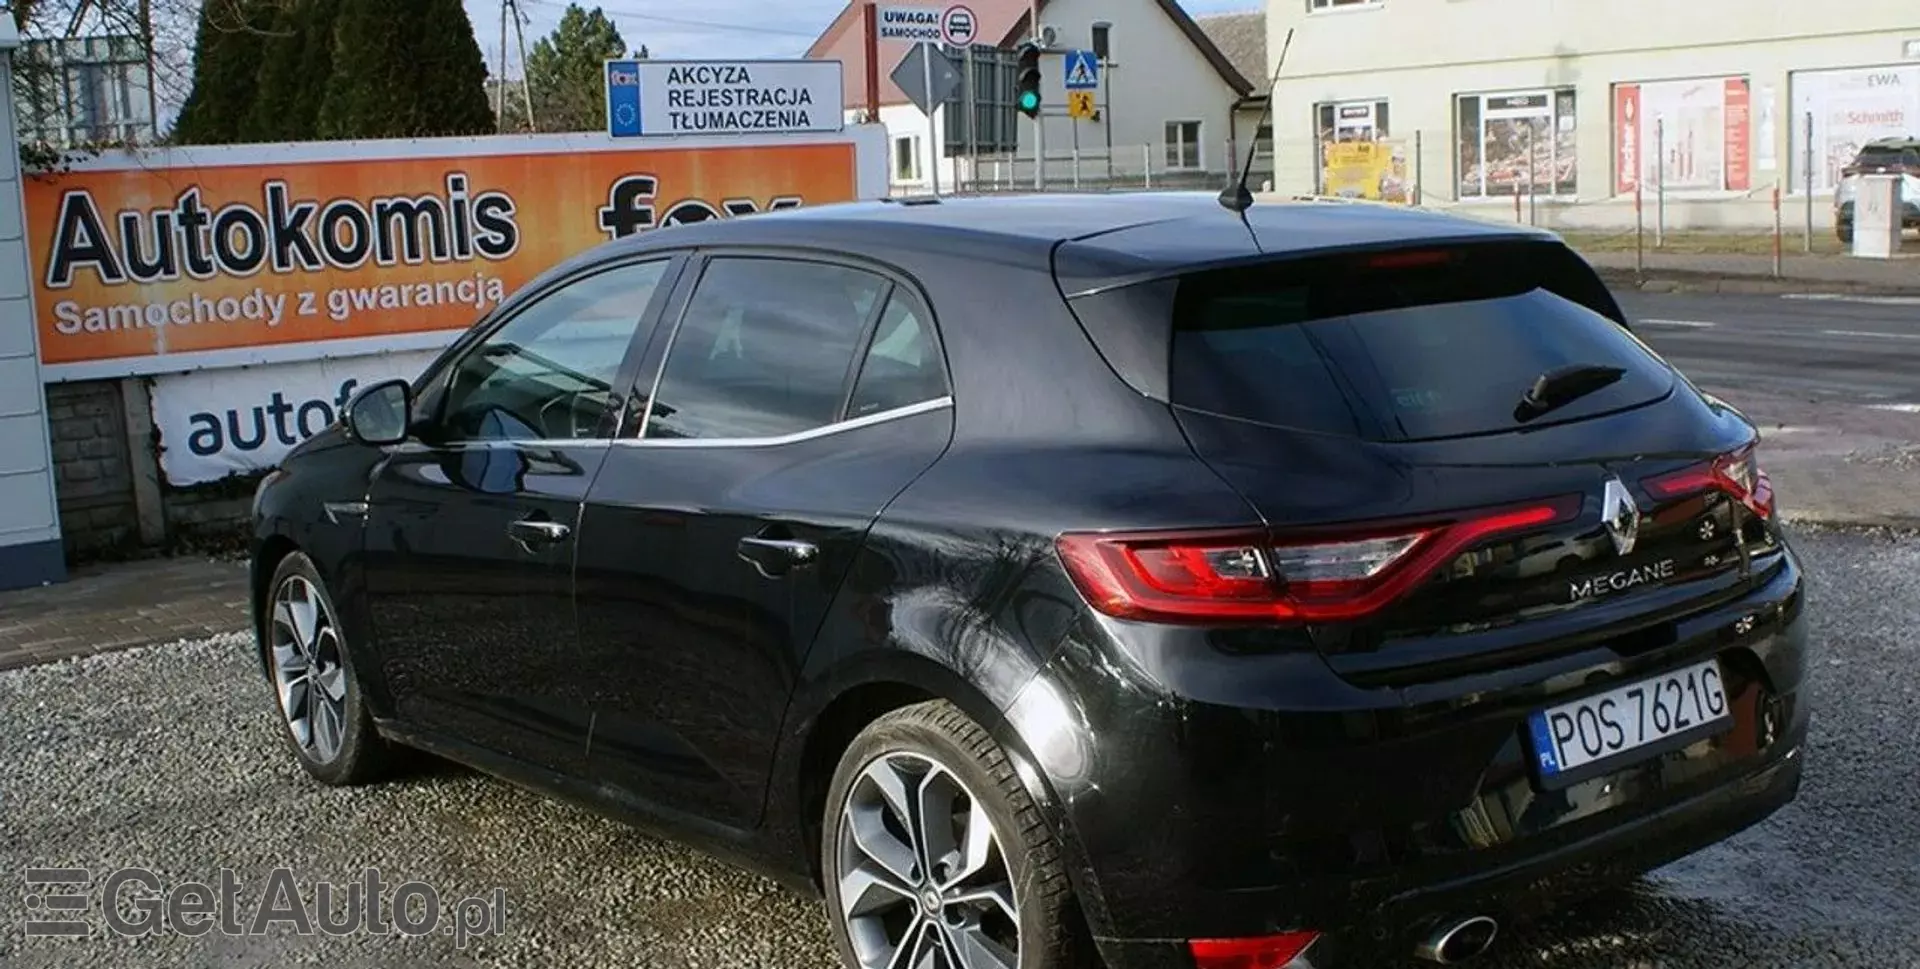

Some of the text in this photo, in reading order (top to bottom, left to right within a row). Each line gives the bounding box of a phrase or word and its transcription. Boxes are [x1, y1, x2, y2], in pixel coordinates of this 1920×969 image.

[884, 10, 939, 24] UWAGA!
[667, 67, 750, 85] AKCYZA
[668, 88, 812, 107] REJESTRACJA
[669, 110, 811, 130] TŁUMACZENIA
[47, 173, 519, 289] Autokomis
[54, 271, 505, 334] Samochody z gwarancją
[1569, 558, 1675, 601] MEGANE
[1550, 667, 1725, 767] POS 7621G
[1540, 751, 1556, 768] PL
